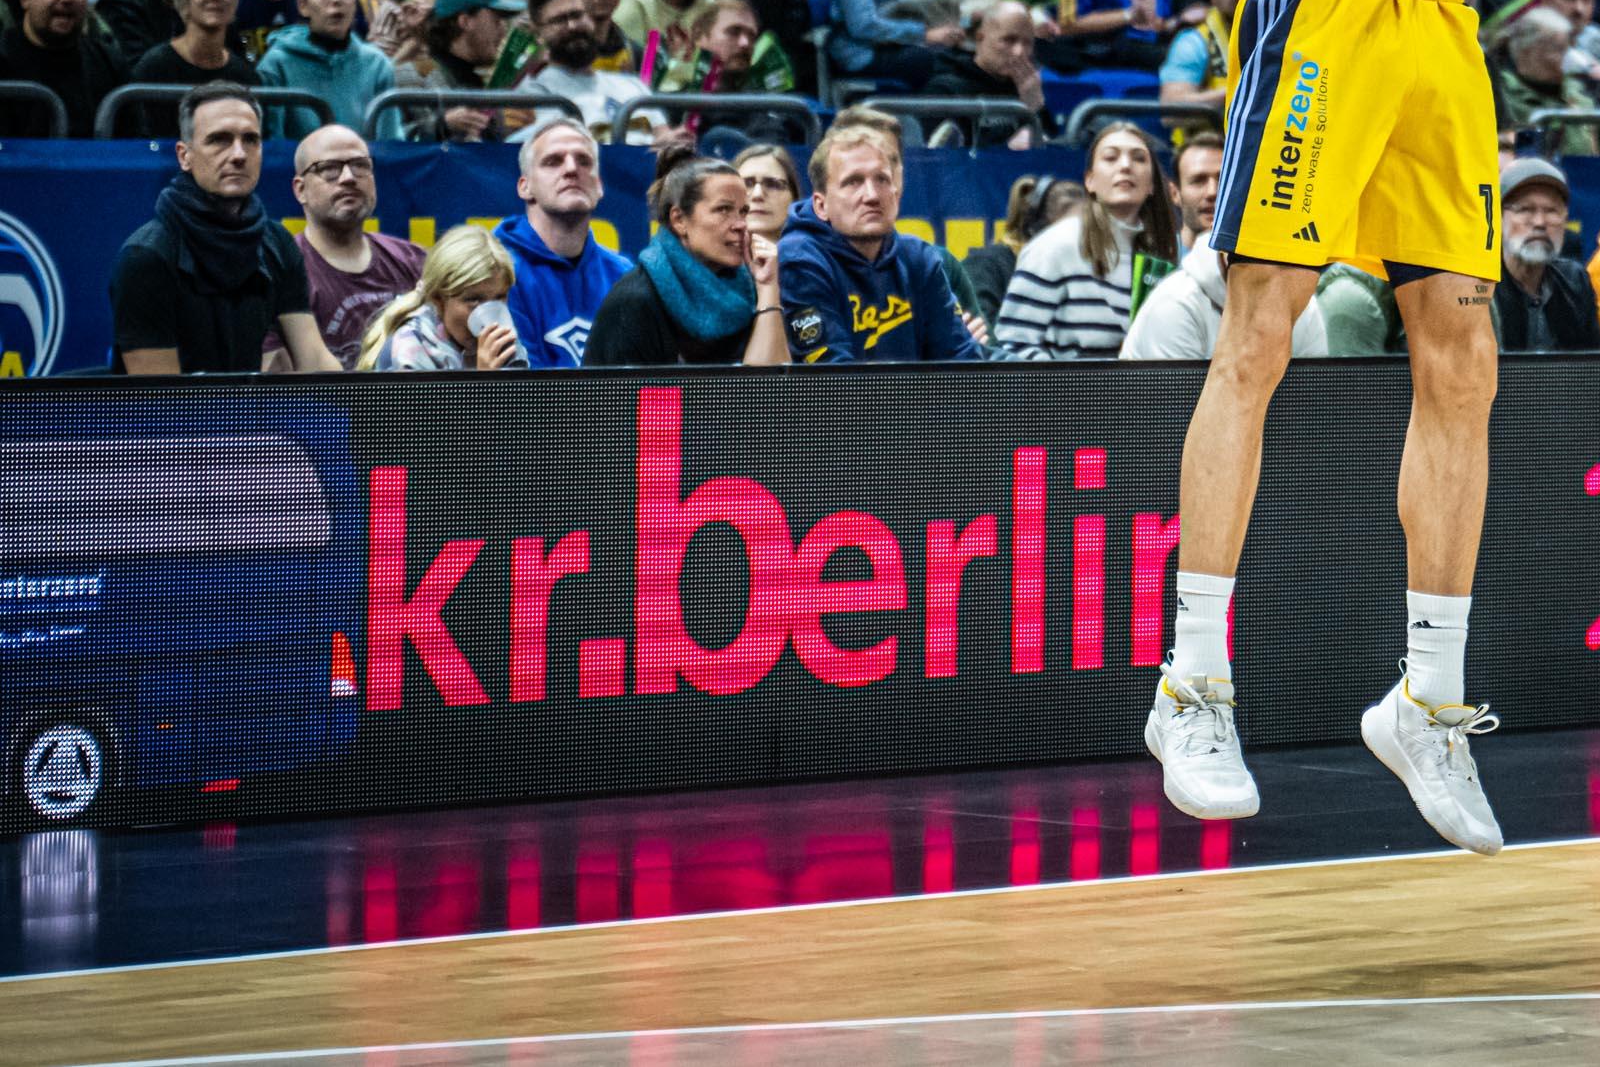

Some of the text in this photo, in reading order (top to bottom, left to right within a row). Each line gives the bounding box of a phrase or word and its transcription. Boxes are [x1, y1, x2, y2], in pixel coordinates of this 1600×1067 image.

[1260, 60, 1320, 211] interzero
[1301, 67, 1330, 214] zero waste solutions
[1479, 184, 1494, 251] 1
